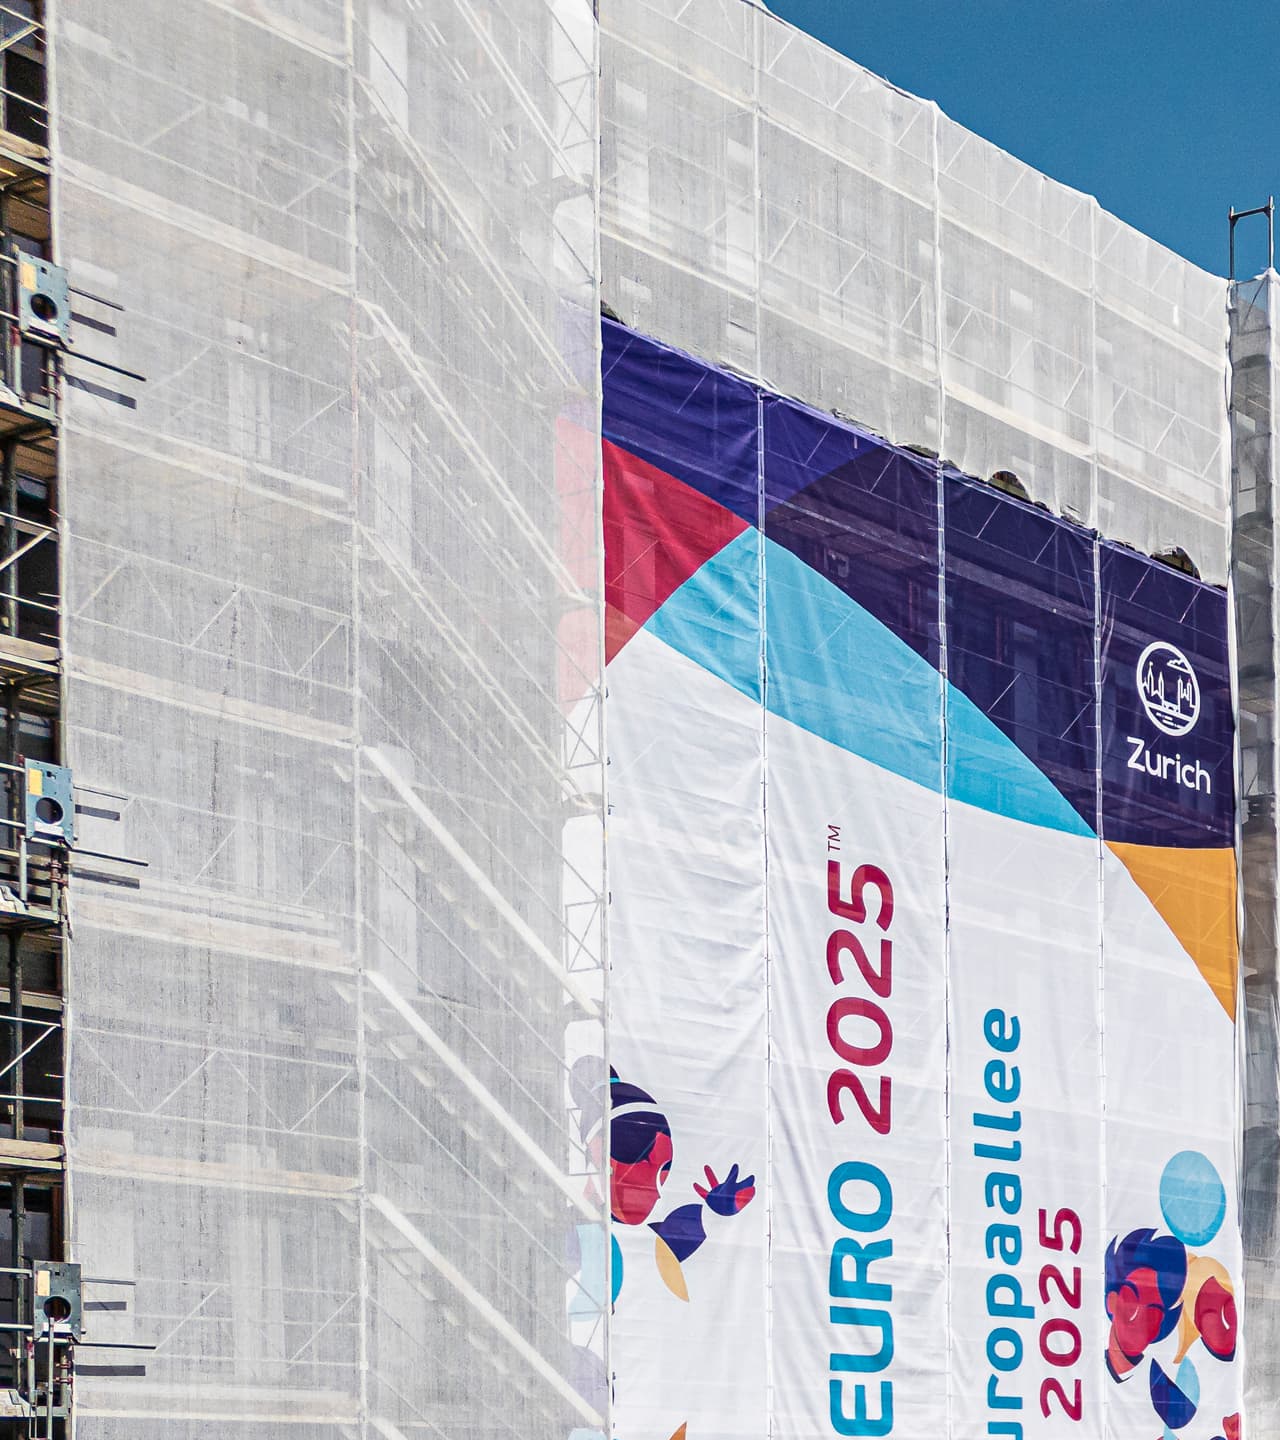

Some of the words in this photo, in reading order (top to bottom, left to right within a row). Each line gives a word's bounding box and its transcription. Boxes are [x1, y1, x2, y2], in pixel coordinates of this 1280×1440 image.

[1127, 736, 1211, 794] Zurich
[827, 859, 894, 1135] 2025
[827, 1160, 895, 1437] EURO
[1038, 1208, 1082, 1422] 2025
